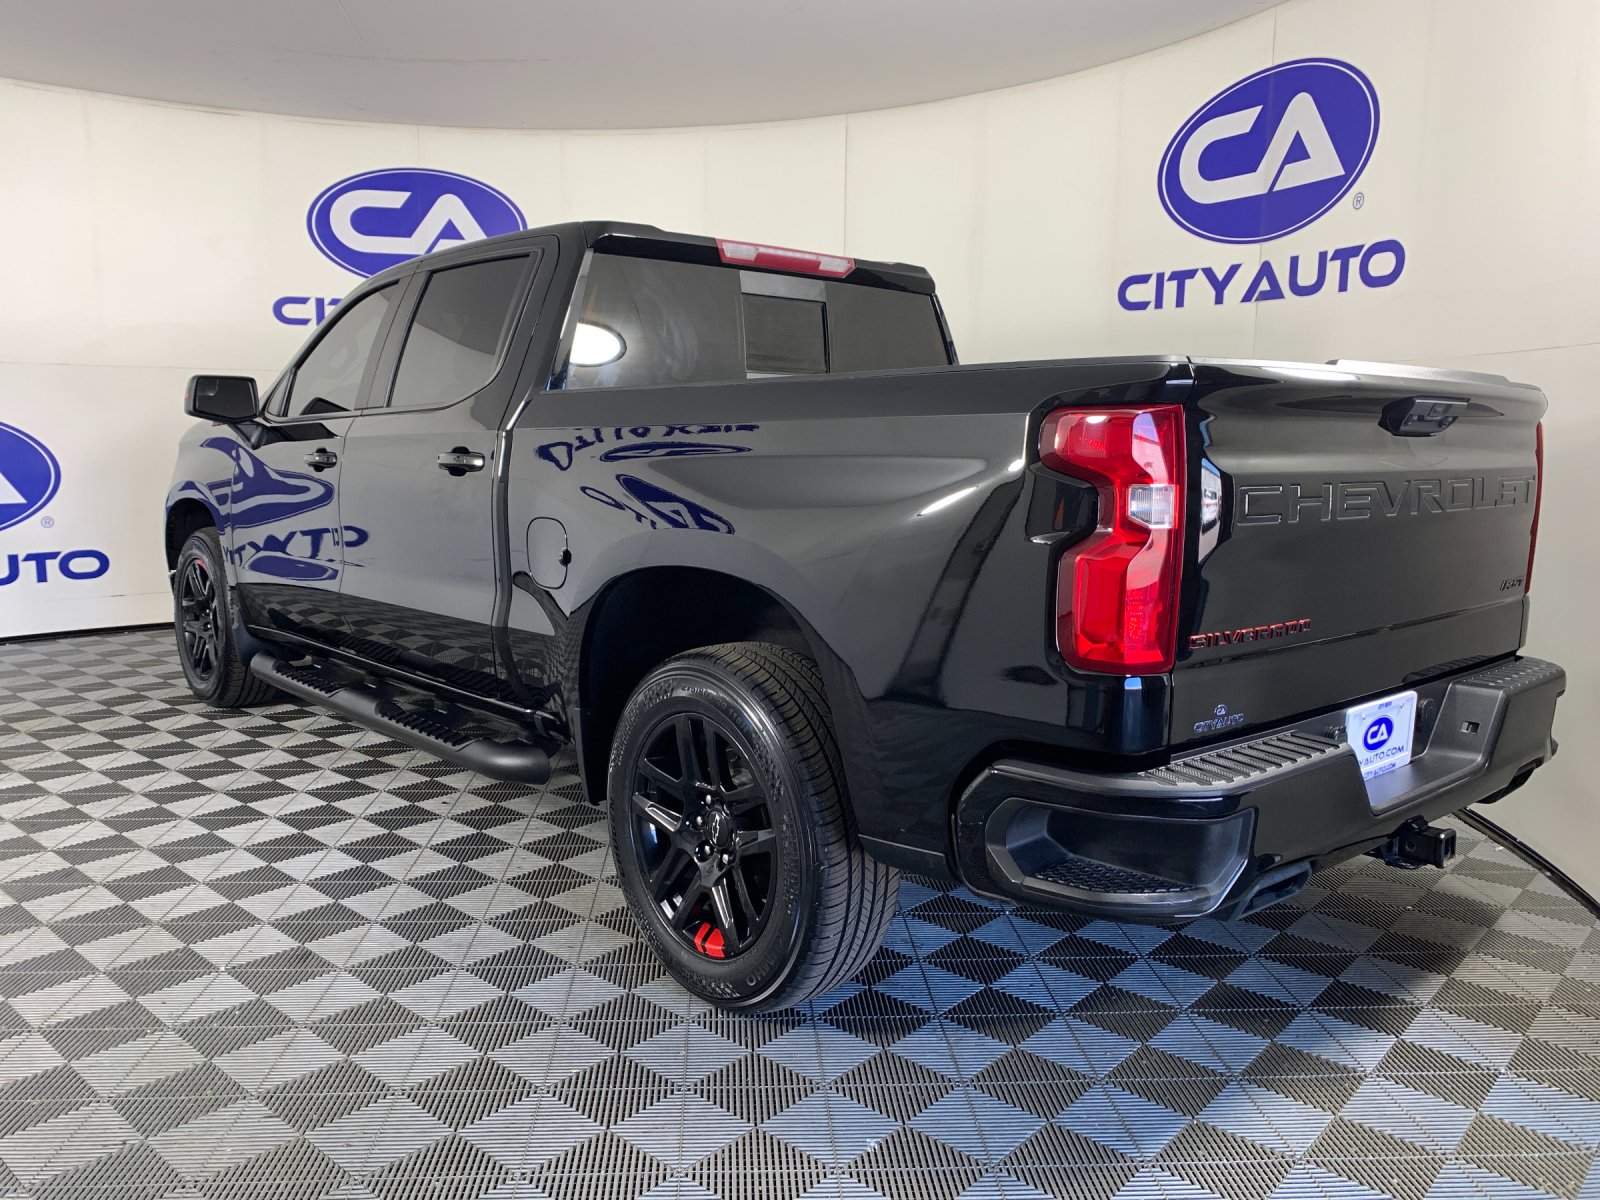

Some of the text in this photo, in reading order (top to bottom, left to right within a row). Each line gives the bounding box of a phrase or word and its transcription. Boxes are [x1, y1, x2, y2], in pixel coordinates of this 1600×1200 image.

[1179, 91, 1346, 204] CA
[1237, 474, 1536, 526] CHEVROLET
[1367, 723, 1389, 745] CA
